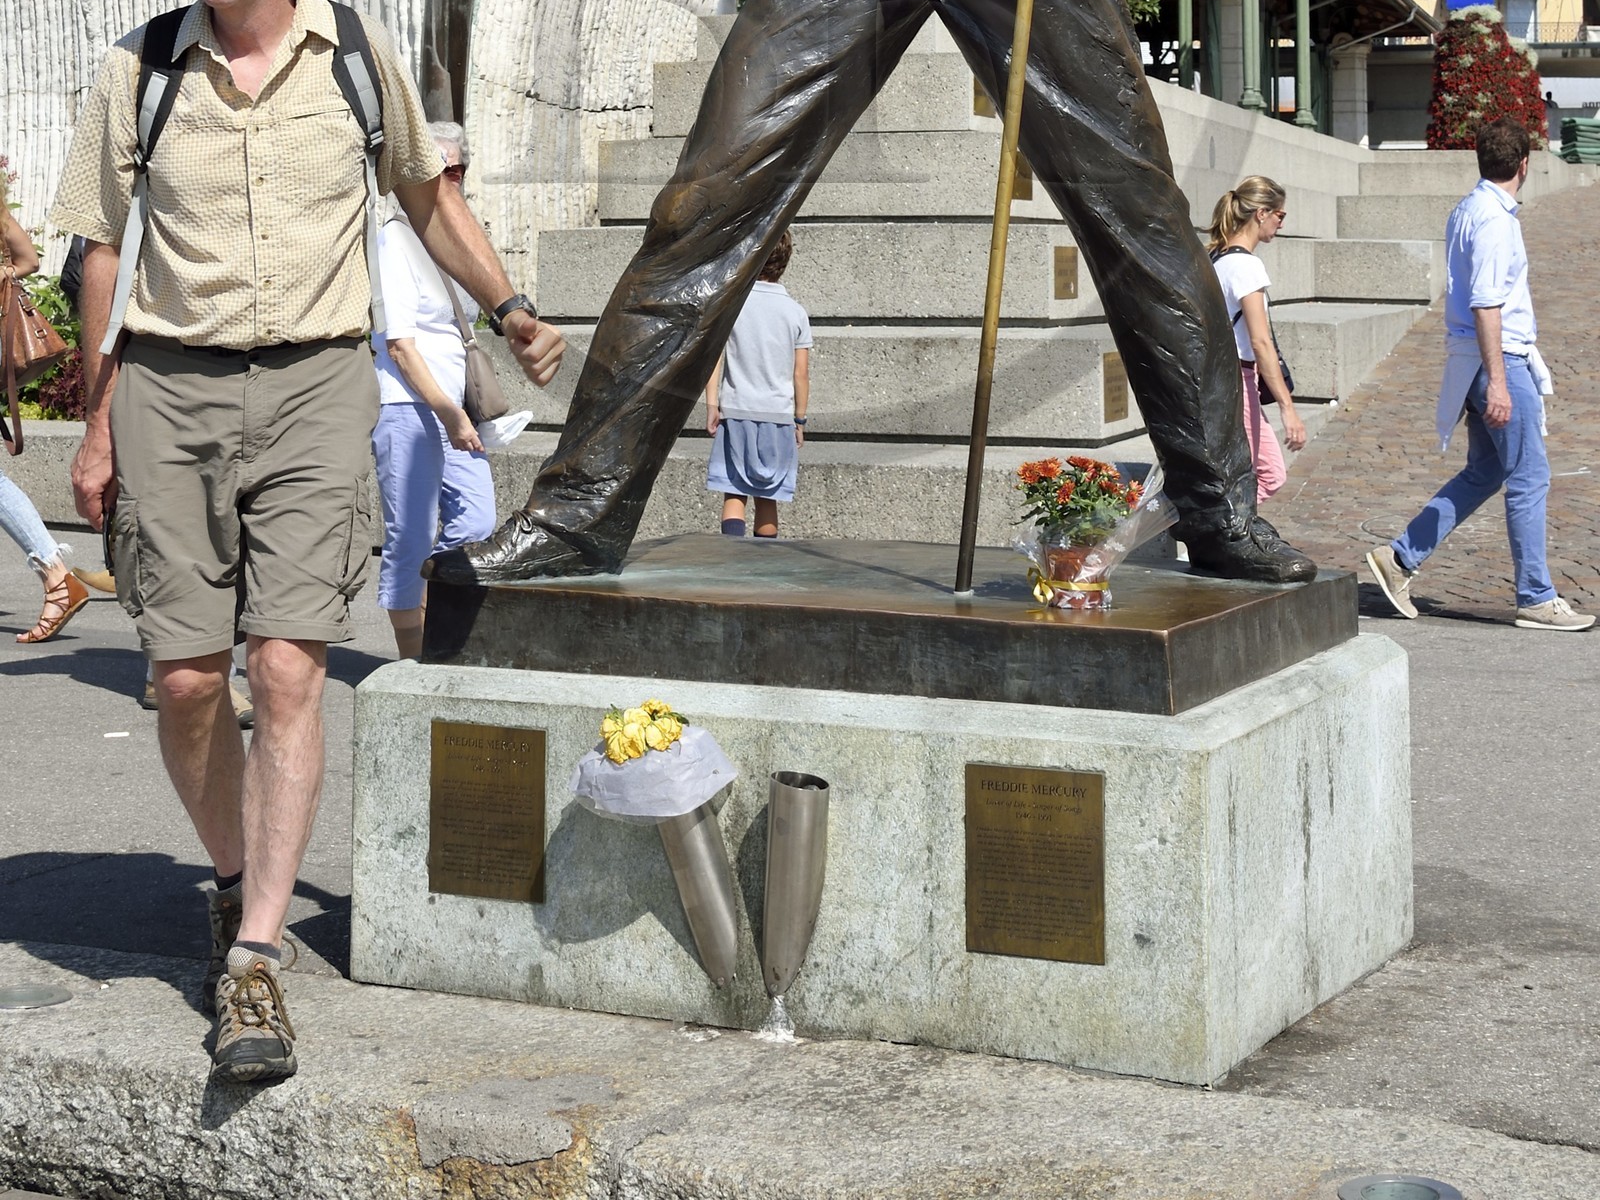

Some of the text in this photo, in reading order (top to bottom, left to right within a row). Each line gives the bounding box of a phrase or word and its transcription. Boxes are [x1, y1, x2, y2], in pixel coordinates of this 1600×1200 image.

[444, 735, 532, 753] FREDDIE MERCURY
[980, 779, 1087, 799] FREDDIE MERCURY
